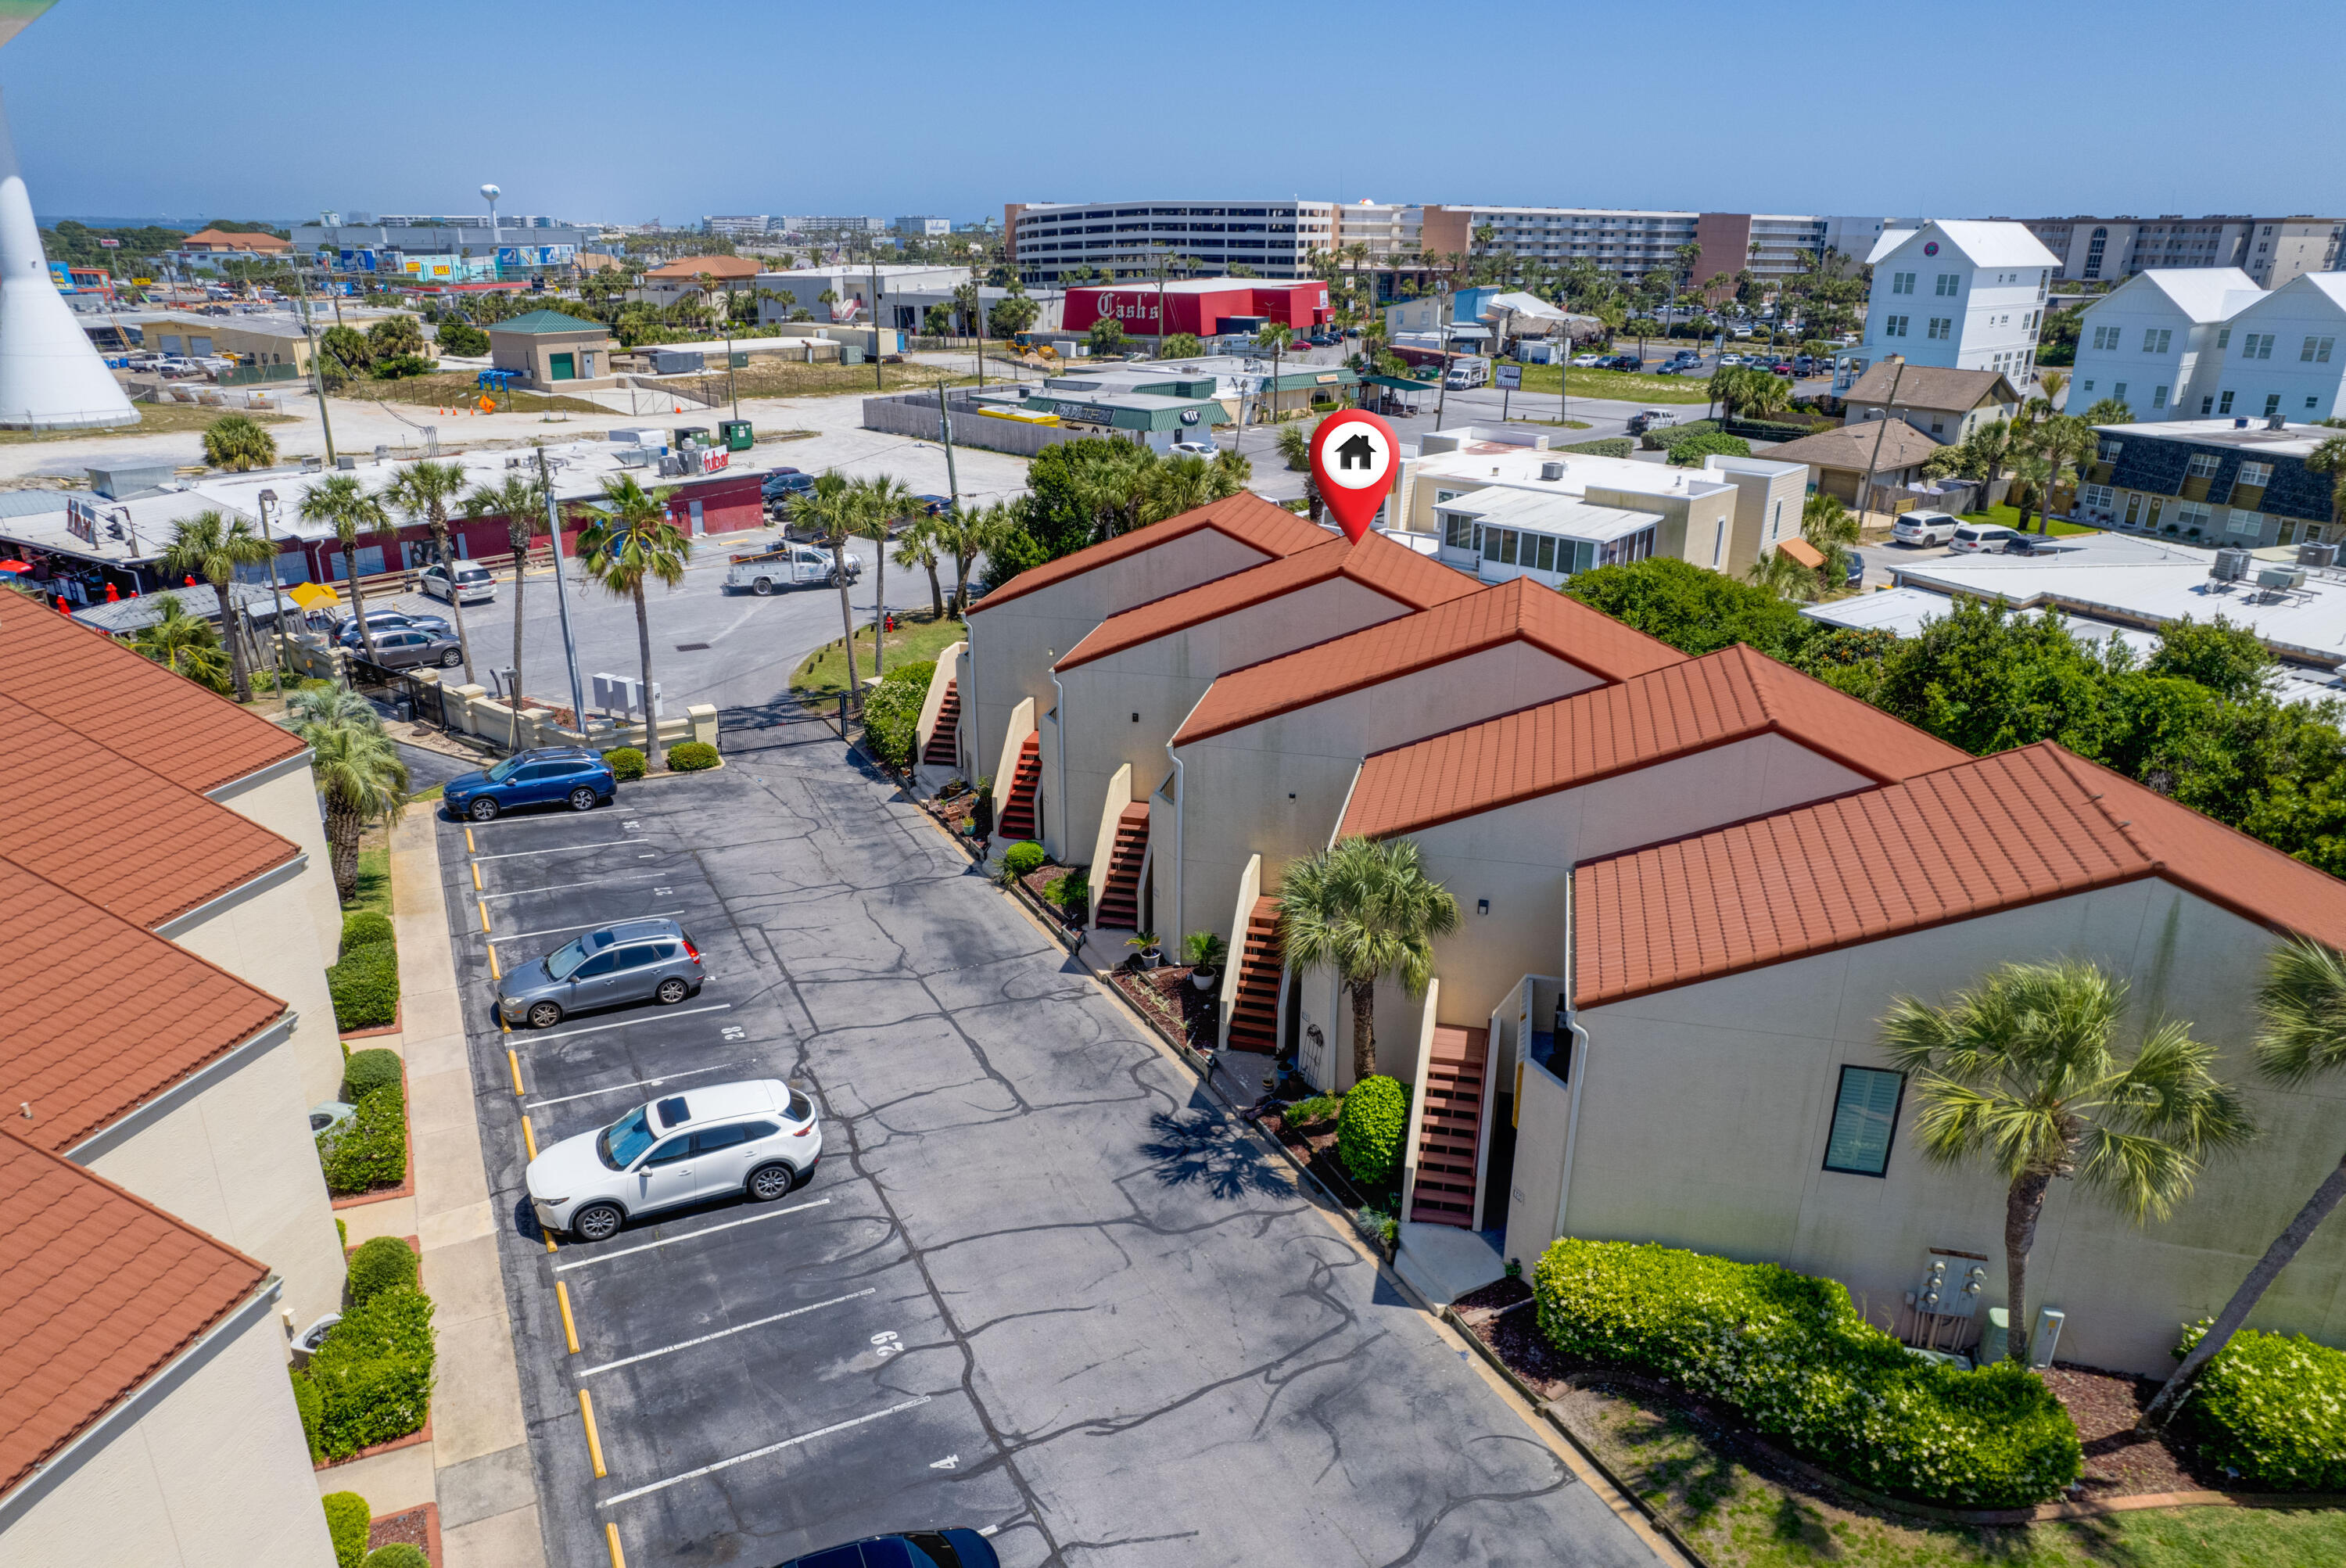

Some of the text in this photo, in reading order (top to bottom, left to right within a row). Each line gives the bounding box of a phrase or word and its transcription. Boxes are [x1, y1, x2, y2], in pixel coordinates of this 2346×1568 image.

[434, 266, 450, 274] SALE
[1097, 292, 1159, 319] Cash's
[704, 450, 730, 472] fubar
[654, 887, 673, 895] 27
[721, 1026, 745, 1040] 28
[870, 1331, 905, 1356] 29
[929, 1454, 960, 1469] 4
